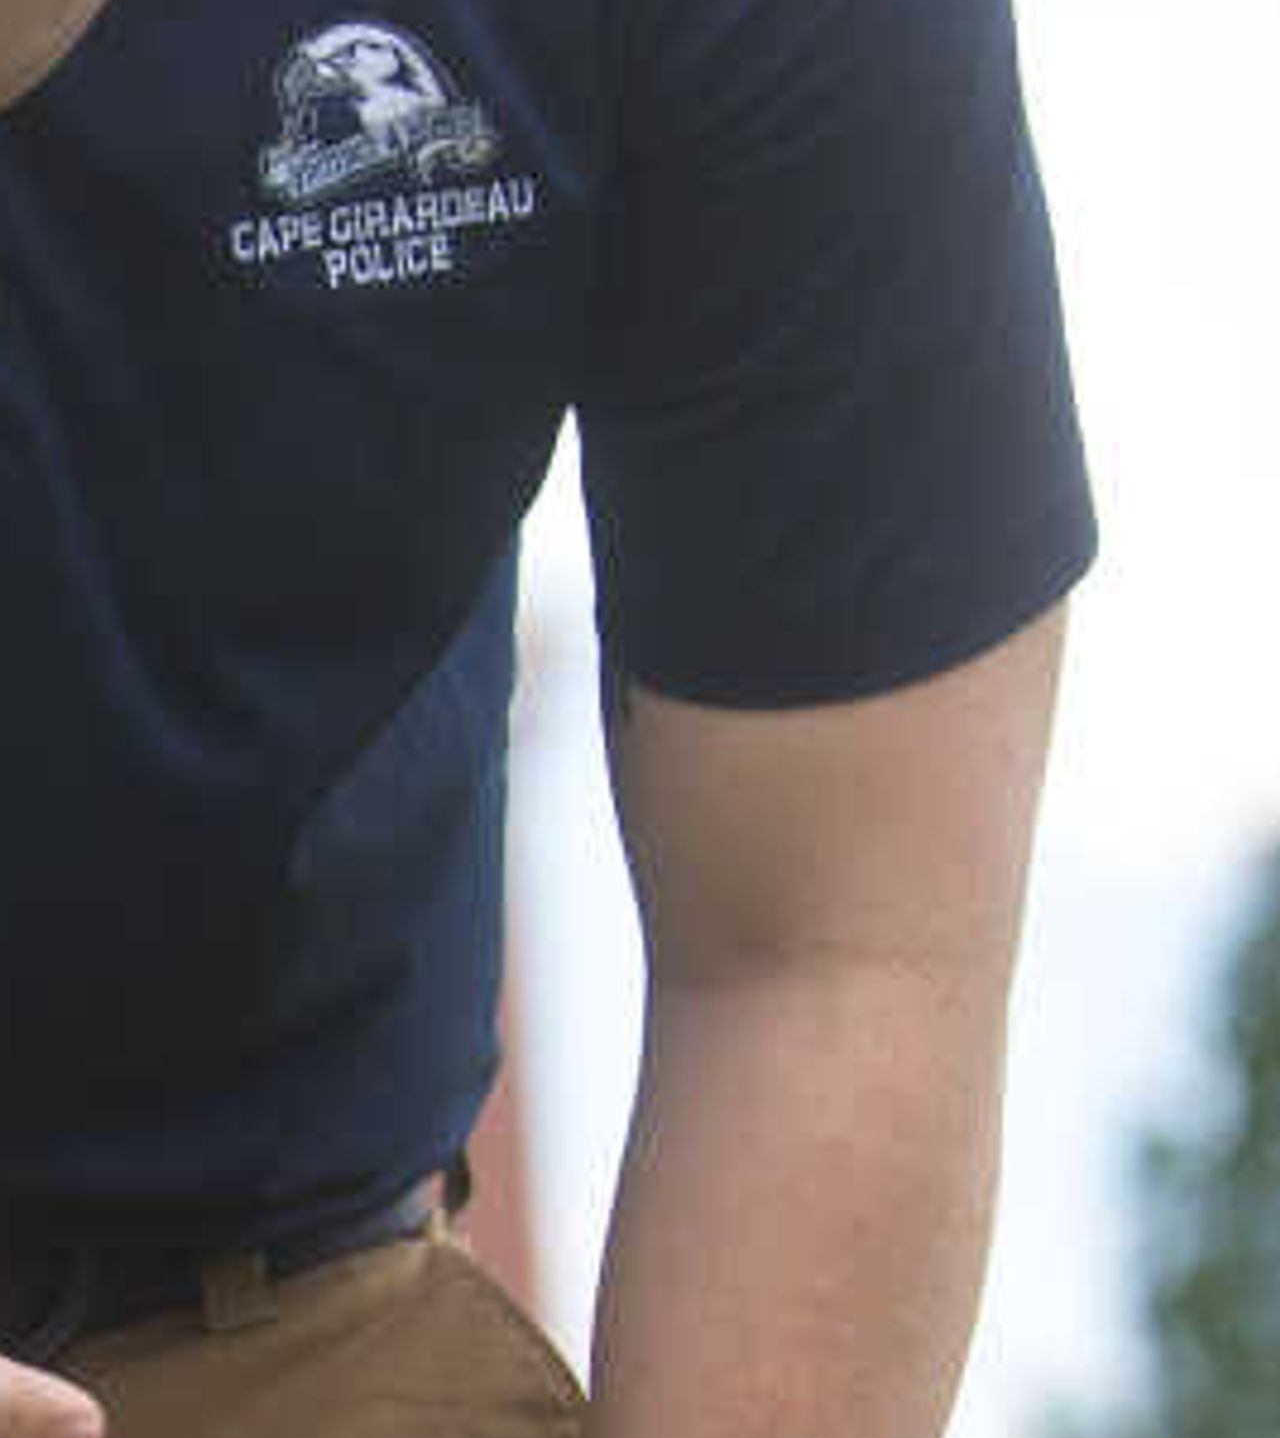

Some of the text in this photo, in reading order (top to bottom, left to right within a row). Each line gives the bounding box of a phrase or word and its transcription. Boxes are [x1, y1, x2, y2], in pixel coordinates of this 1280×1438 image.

[231, 178, 536, 262] CAPE GIRARDEAU
[324, 234, 453, 289] POLICE
